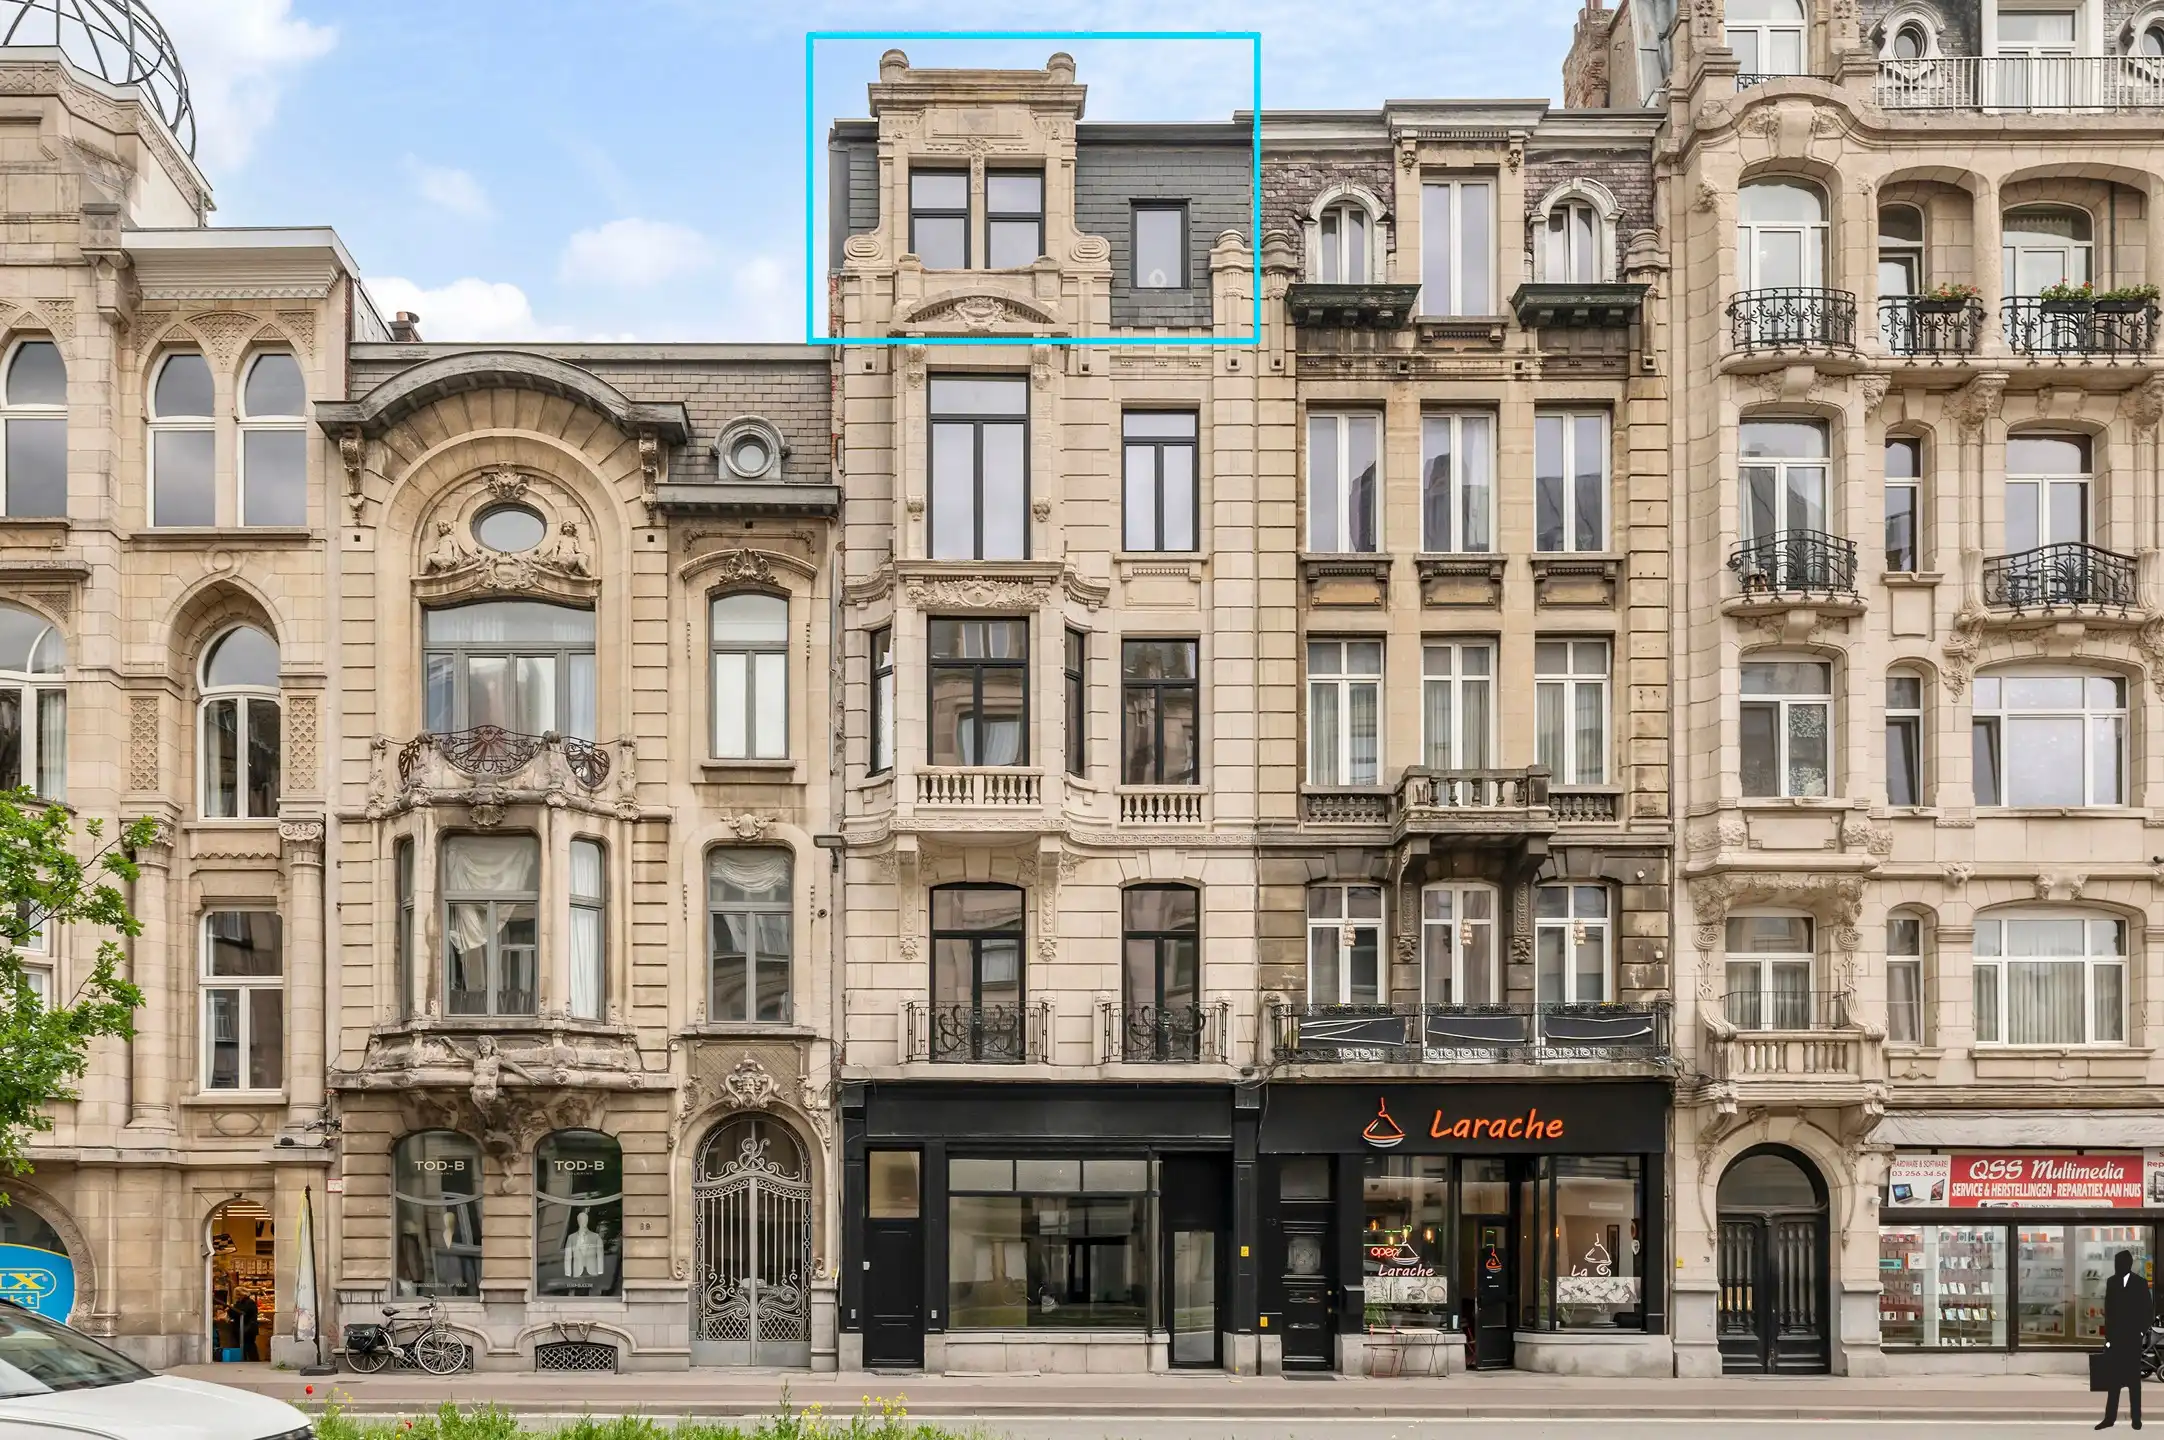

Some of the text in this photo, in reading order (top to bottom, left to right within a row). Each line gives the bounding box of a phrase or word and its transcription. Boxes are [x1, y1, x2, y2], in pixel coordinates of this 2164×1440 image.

[1430, 1107, 1564, 1139] Larache
[414, 1160, 465, 1171] TOD-B
[554, 1160, 605, 1171] TOD-B
[1969, 1159, 2124, 1180] QSS Multimedia
[1952, 1182, 1983, 1197] SERVICE
[1984, 1182, 1990, 1197] &
[1991, 1182, 2052, 1197] HERSTELLINGEN
[2057, 1183, 2103, 1197] REPARATIES
[2104, 1183, 2122, 1197] AAN
[2123, 1183, 2141, 1198] HUIS
[1378, 1263, 1435, 1277] Larache
[1571, 1264, 1588, 1277] La
[0, 1273, 45, 1289] X
